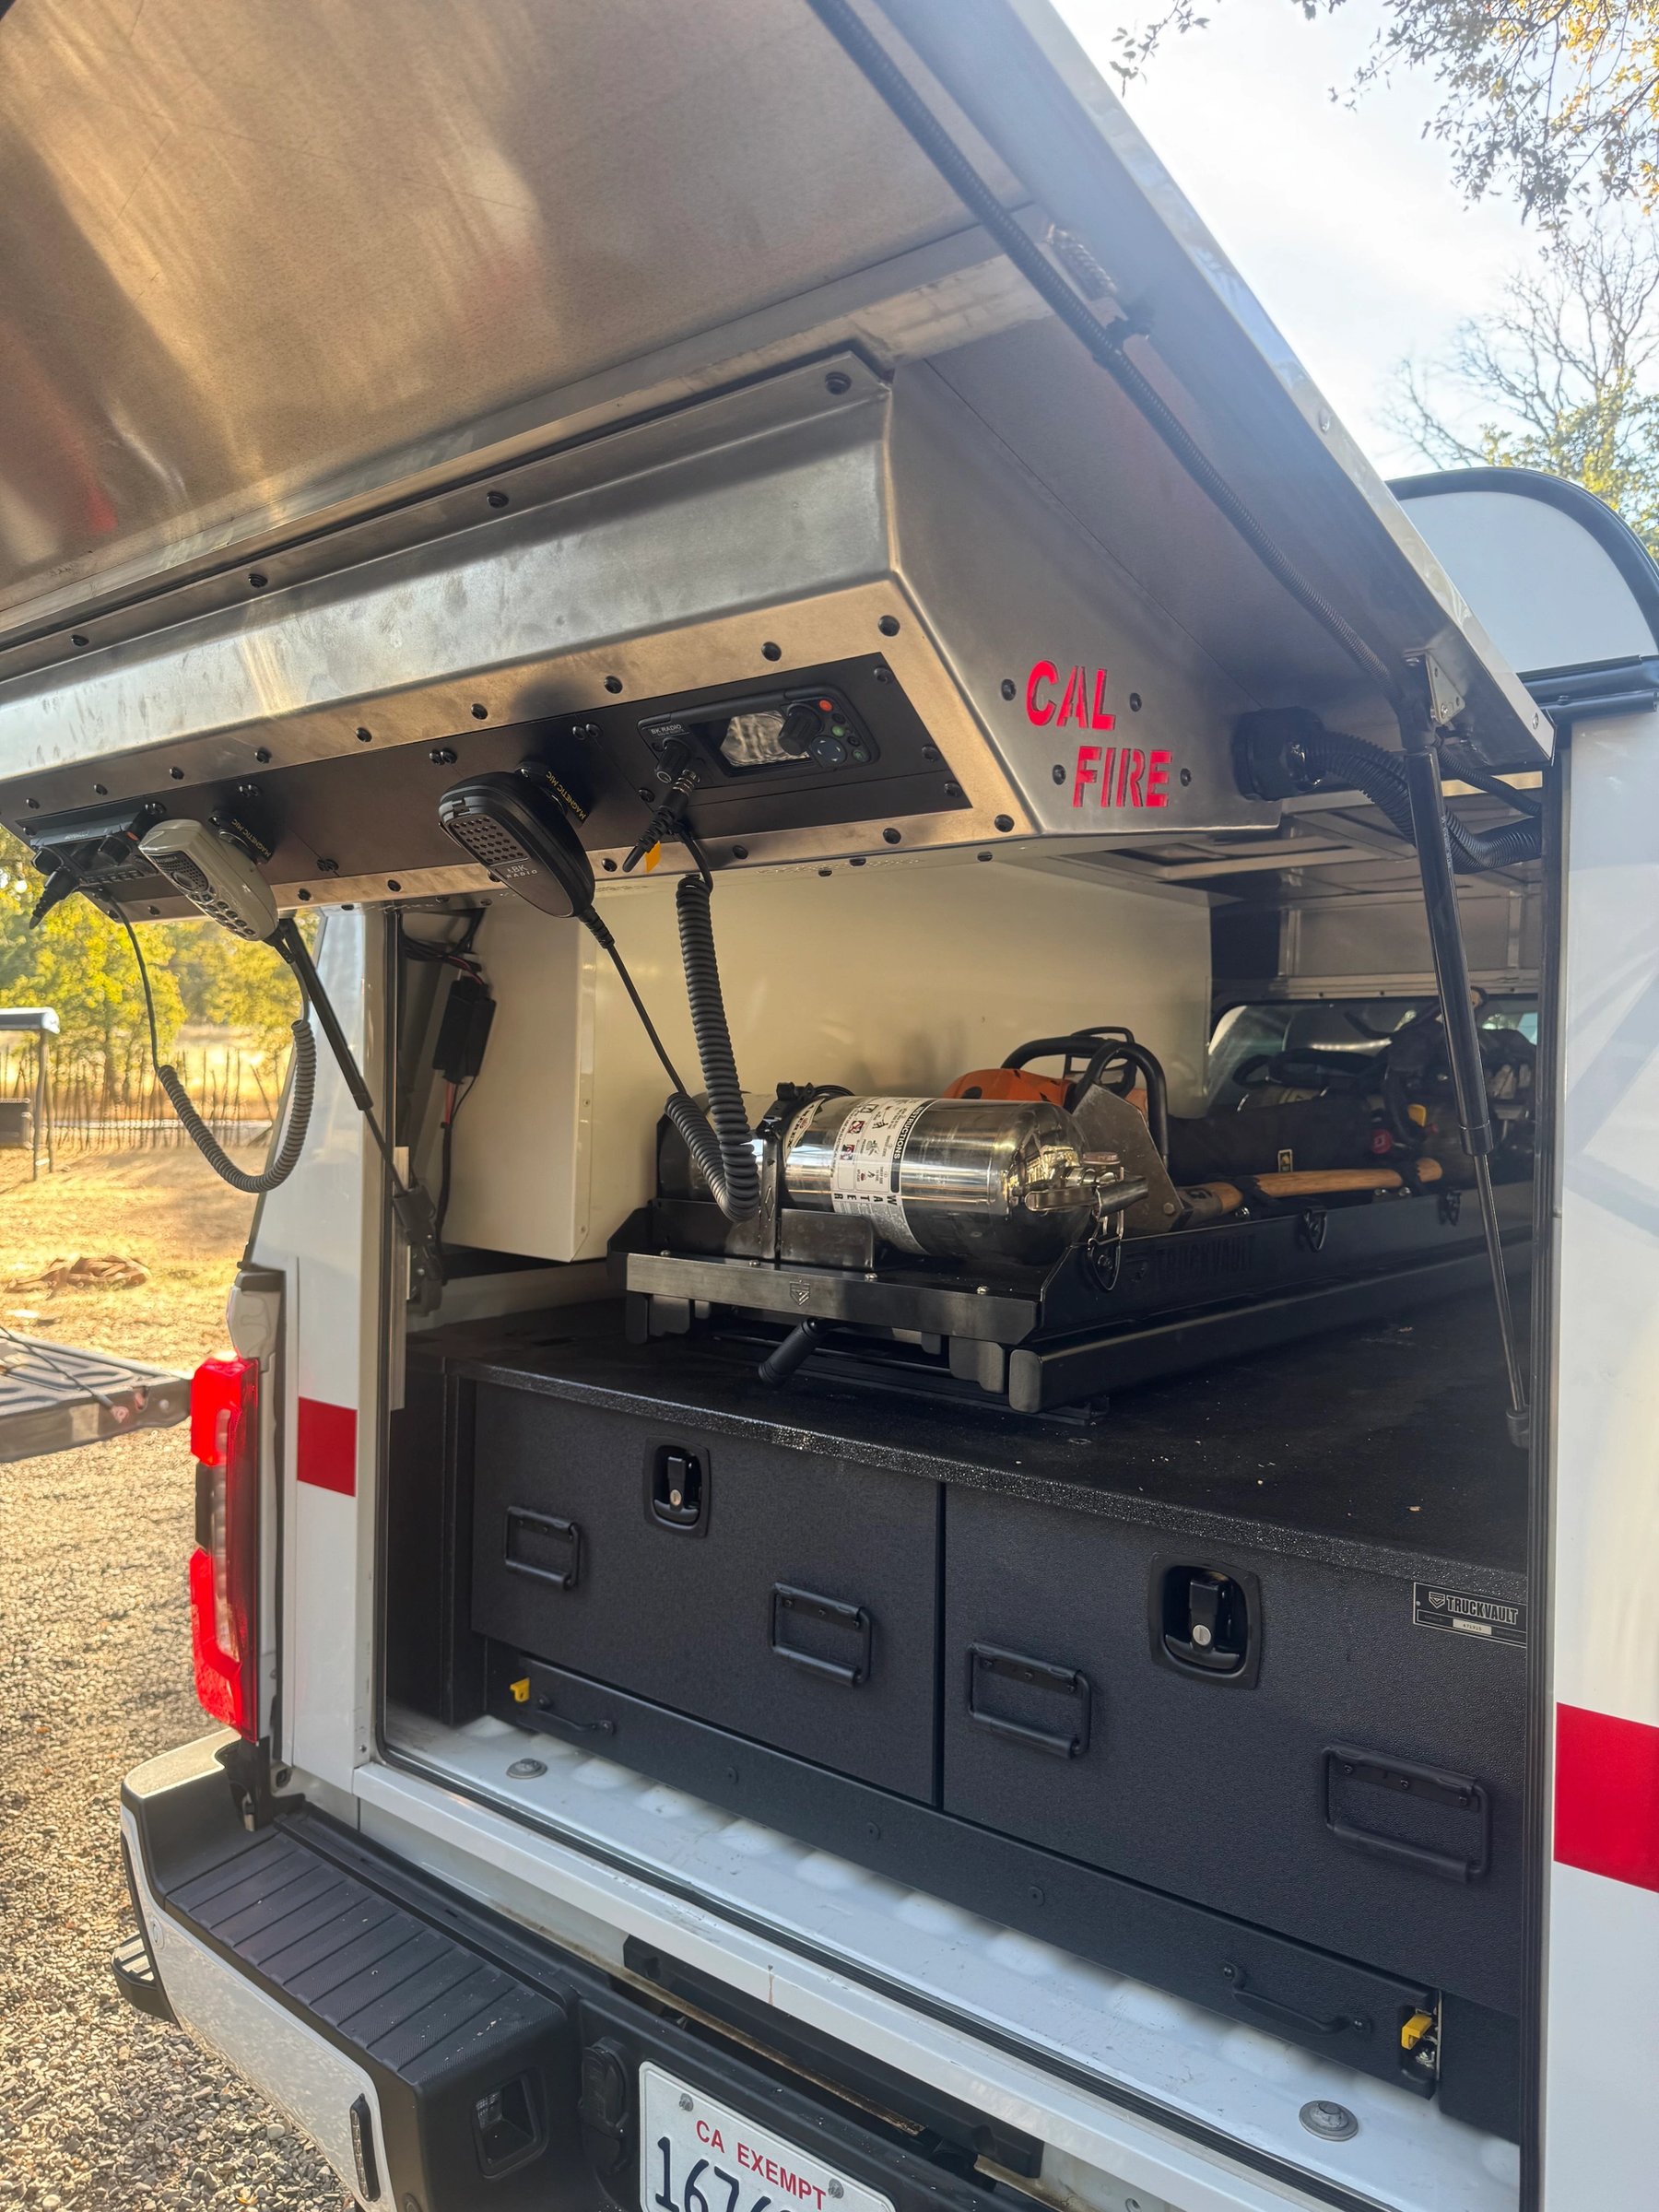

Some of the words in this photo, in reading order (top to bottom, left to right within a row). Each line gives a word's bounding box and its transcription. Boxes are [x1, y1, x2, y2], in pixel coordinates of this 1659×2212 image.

[1025, 660, 1116, 731] CAL
[546, 771, 559, 787] MIC
[1073, 746, 1172, 807] FIRE
[557, 783, 587, 820] MAGNETIC
[231, 818, 244, 831] MIC
[243, 828, 271, 857] MAGNETIC
[506, 869, 538, 878] RADIO
[893, 1106, 925, 1159] INSTRUCTIONS
[833, 1193, 898, 1206] WATER
[1446, 1594, 1519, 1625] TRUCKVAULT
[696, 2120, 725, 2153] CA
[737, 2142, 827, 2210] EXEMPT
